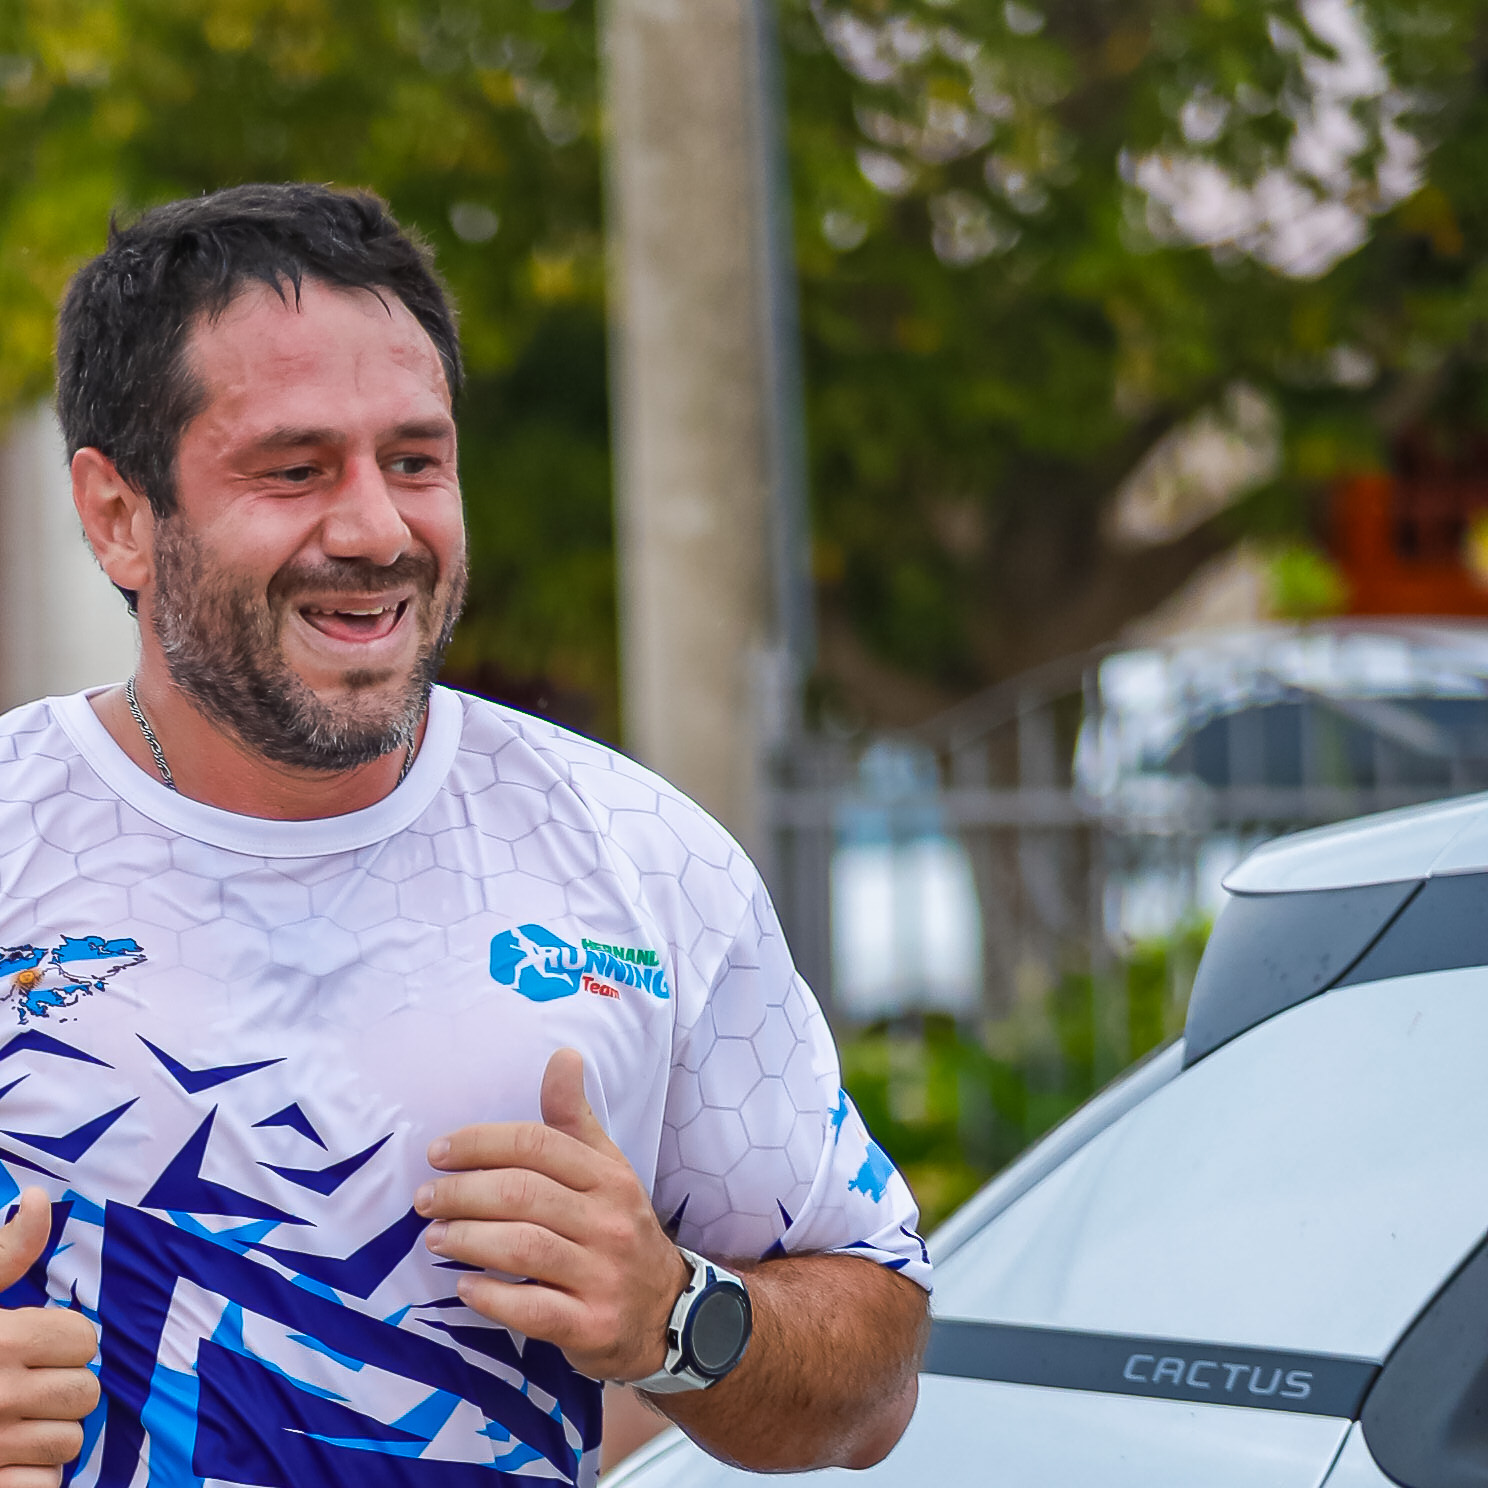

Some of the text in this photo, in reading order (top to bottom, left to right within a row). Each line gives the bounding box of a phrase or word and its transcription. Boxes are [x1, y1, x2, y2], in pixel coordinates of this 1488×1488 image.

[539, 946, 670, 1000] RUNNING
[582, 975, 620, 999] Team
[1123, 1354, 1314, 1399] CACTUS
